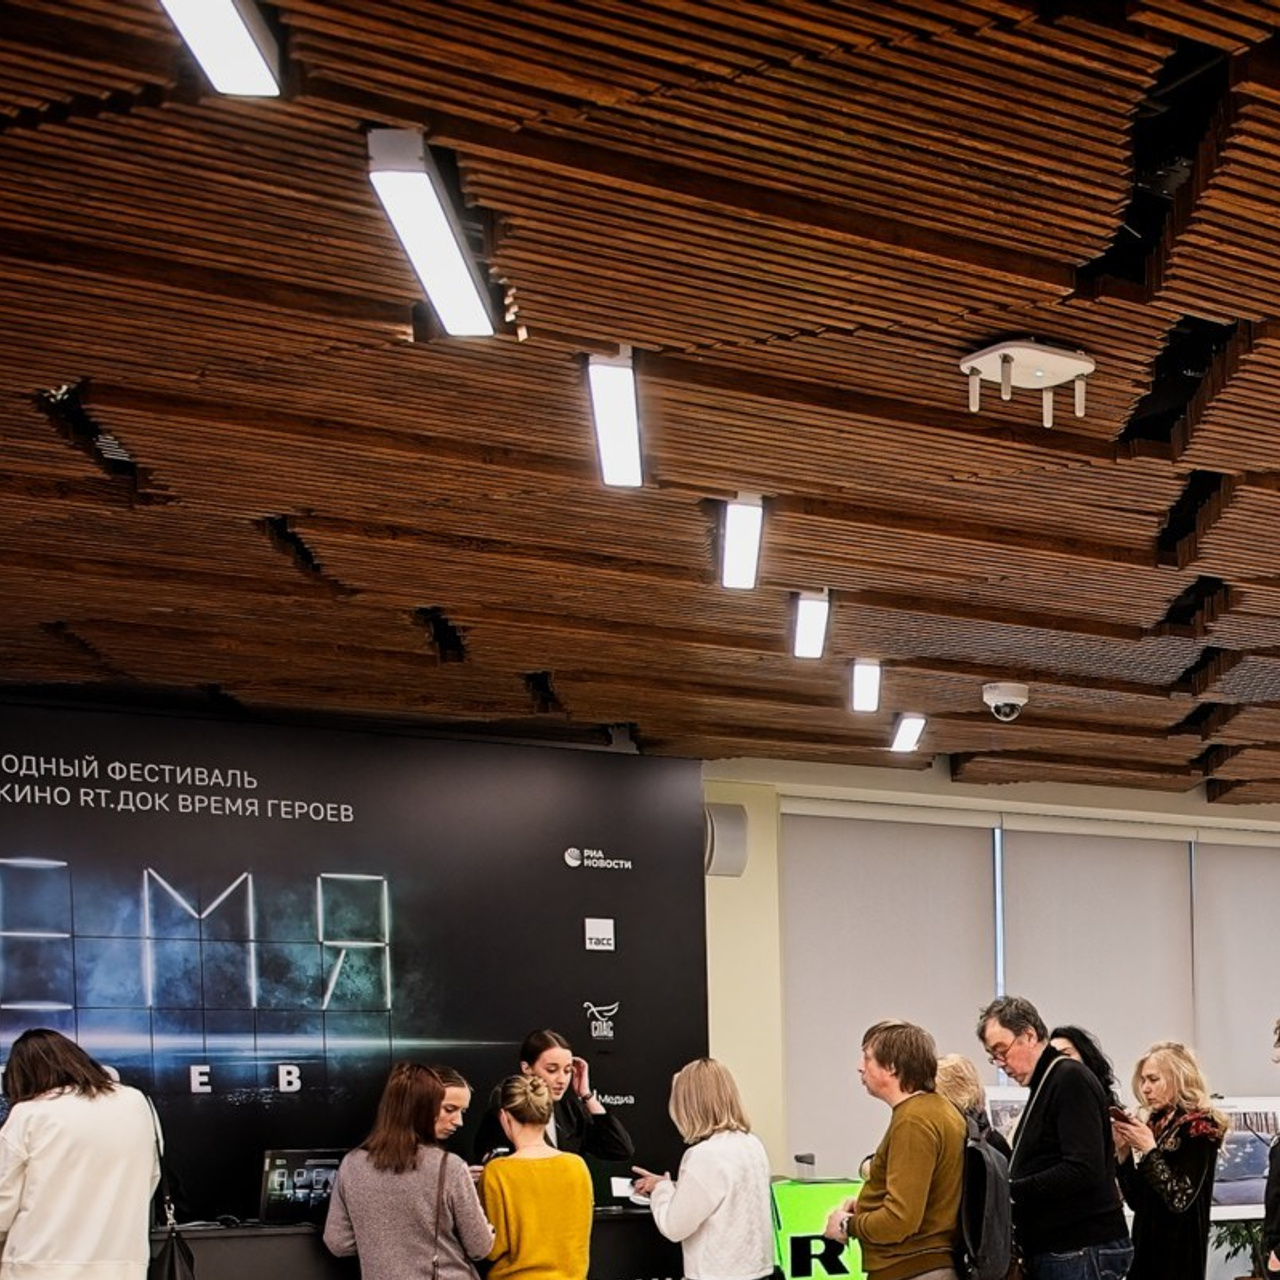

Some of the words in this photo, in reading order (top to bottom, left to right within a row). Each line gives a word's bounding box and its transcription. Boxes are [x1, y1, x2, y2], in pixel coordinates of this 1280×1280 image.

[107, 761, 258, 789] ФЕСТИВАЛЬ
[79, 788, 170, 813] RT.ДОК
[177, 794, 259, 817] ВРЕМЯ
[267, 799, 354, 822] ГЕРОЕВ
[583, 858, 632, 870] НОВОСТИ
[584, 849, 605, 858] РИА
[790, 1235, 866, 1278] R
